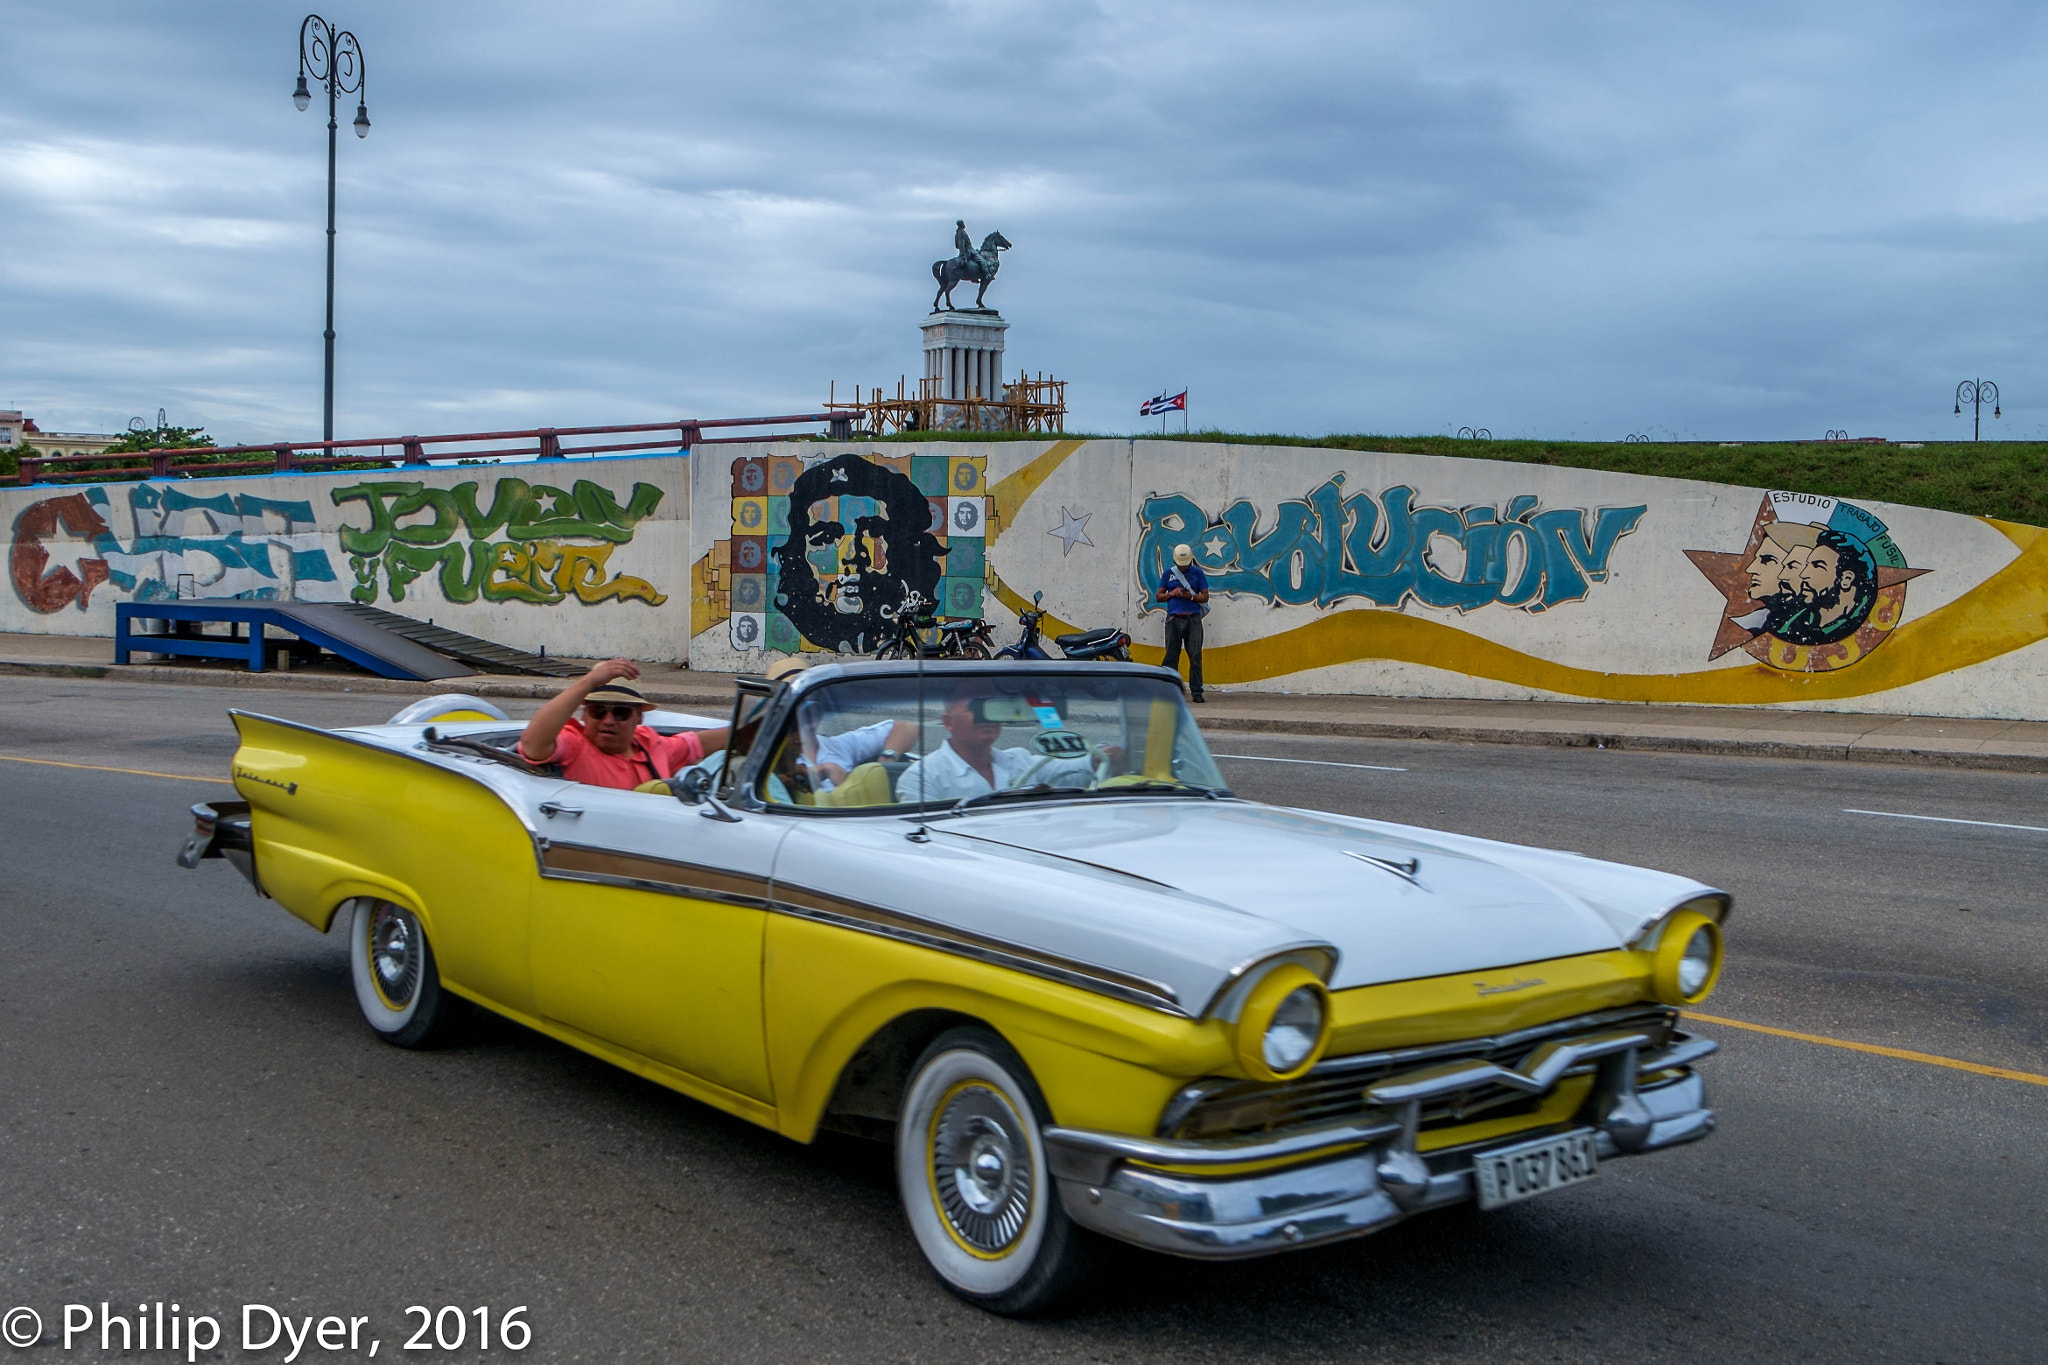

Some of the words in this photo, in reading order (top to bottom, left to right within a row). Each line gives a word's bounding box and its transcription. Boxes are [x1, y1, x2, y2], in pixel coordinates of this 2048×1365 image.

[1773, 491, 1831, 510] ESTUDIO
[1839, 504, 1881, 533] TRABAJO
[1876, 535, 1901, 566] FUSIL
[1037, 735, 1087, 754] TAXI
